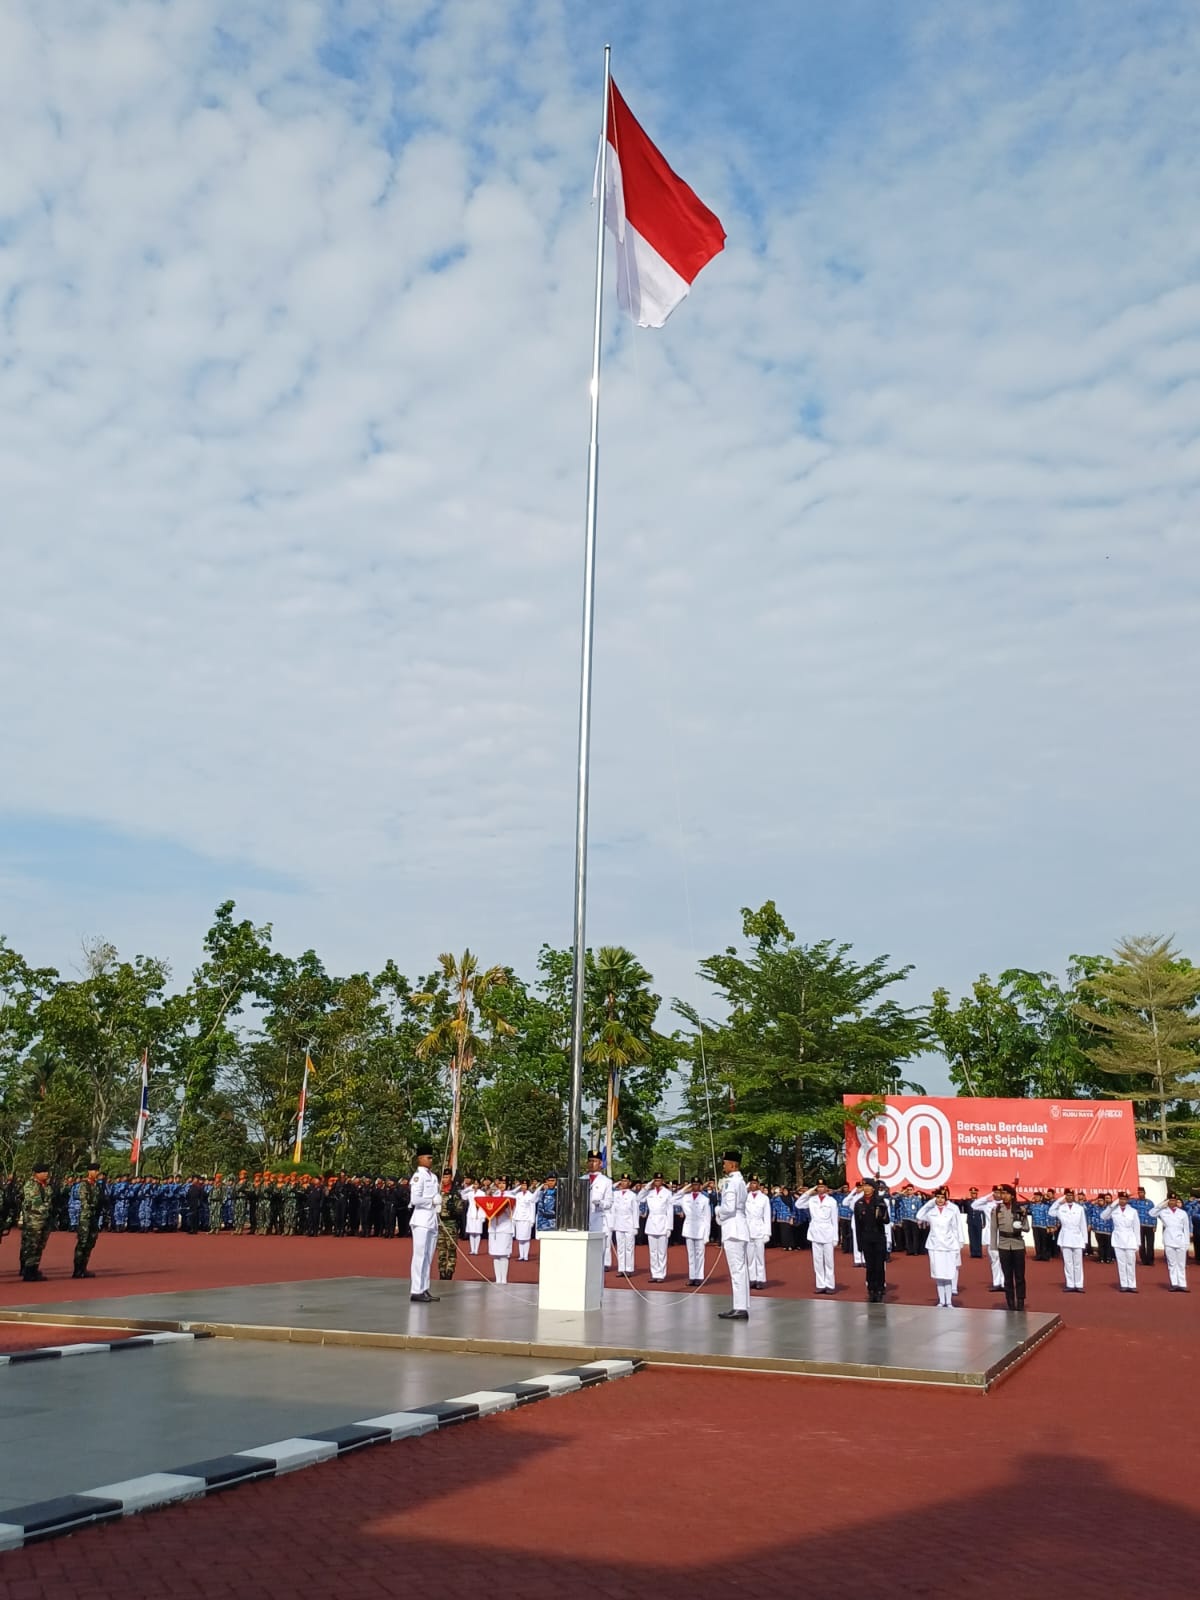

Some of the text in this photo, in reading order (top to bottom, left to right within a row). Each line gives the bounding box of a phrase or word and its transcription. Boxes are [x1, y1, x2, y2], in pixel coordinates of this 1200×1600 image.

[956, 1120, 1048, 1133] Bersatu Berdaulat
[856, 1104, 953, 1190] 80
[957, 1133, 1044, 1147] Rakyat Sejahtera
[958, 1146, 1034, 1160] Indonesia Maju
